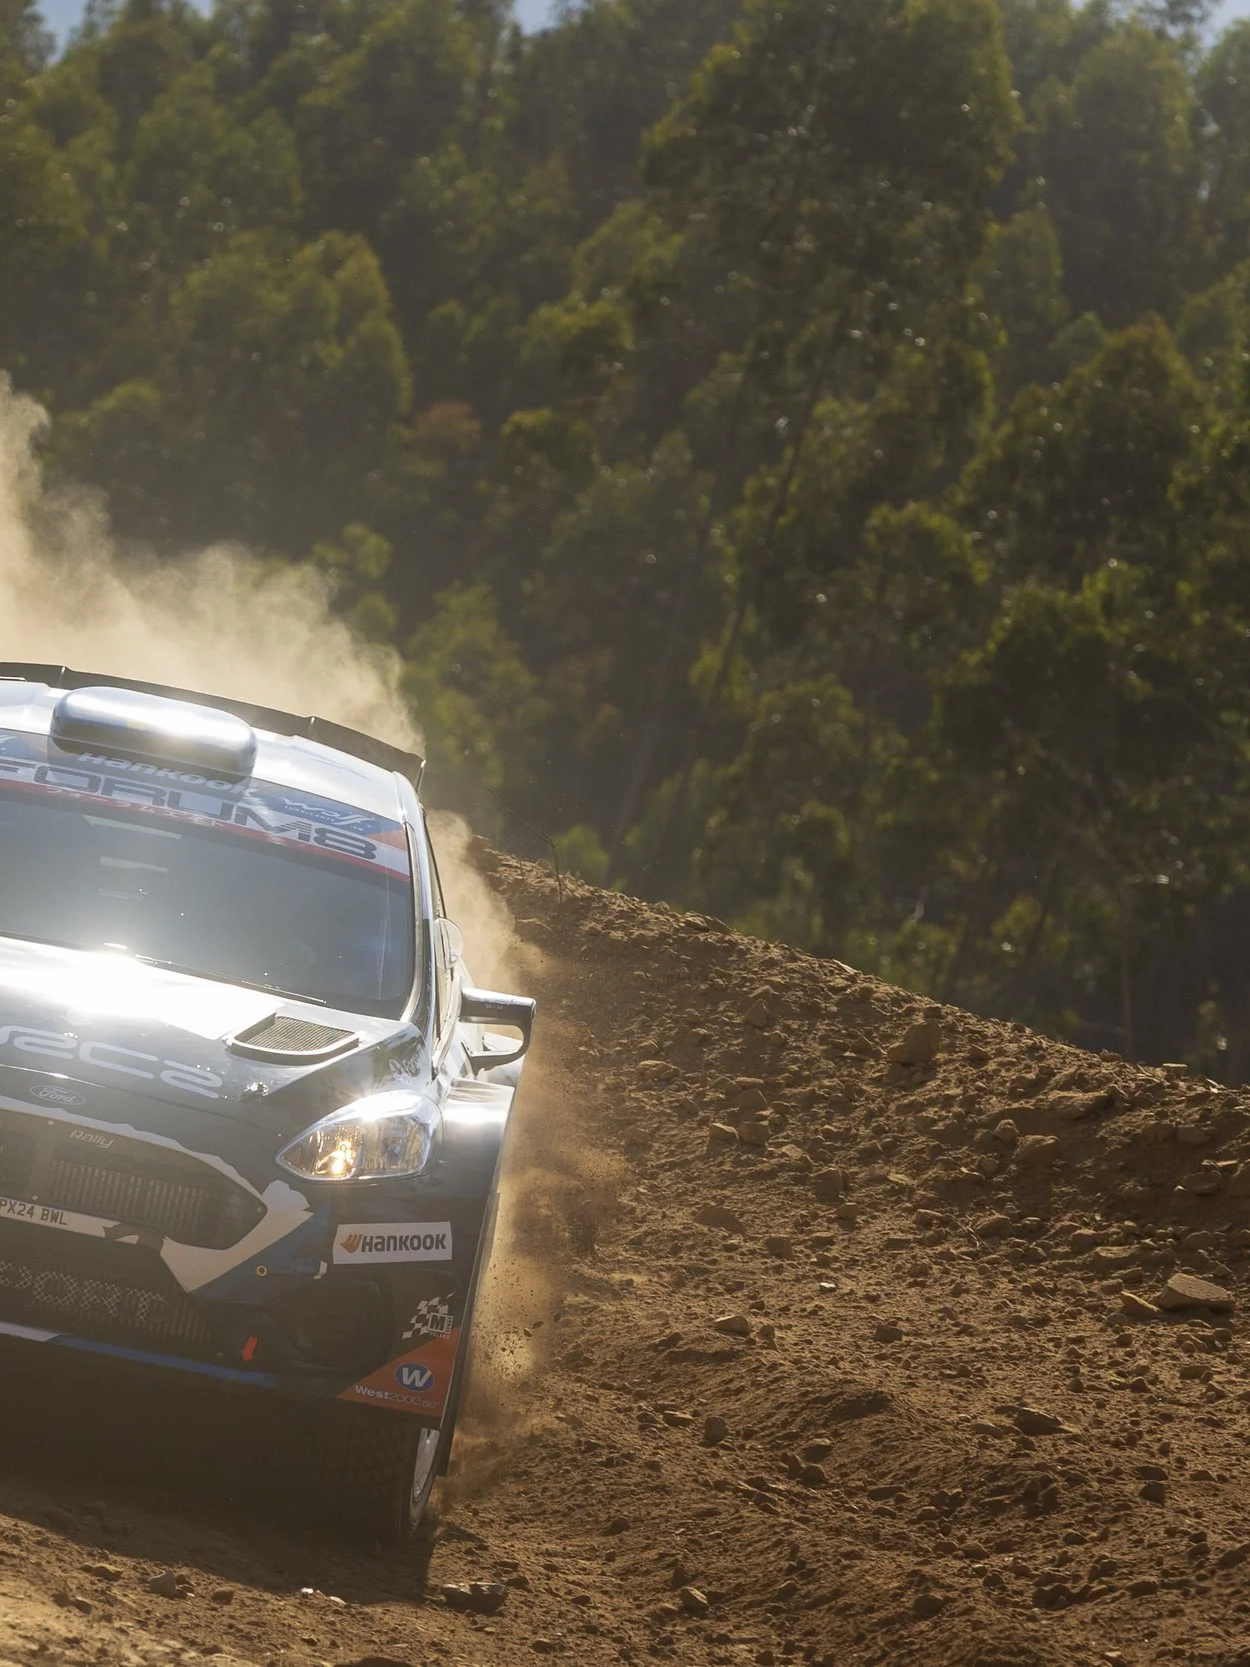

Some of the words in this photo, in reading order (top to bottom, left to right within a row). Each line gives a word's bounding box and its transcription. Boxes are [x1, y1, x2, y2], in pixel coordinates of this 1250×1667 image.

[38, 1085, 78, 1104] Ford
[69, 1129, 115, 1149] Rally
[40, 1208, 68, 1226] BWL
[401, 1367, 432, 1388] W
[354, 1384, 438, 1409] West2000.se
